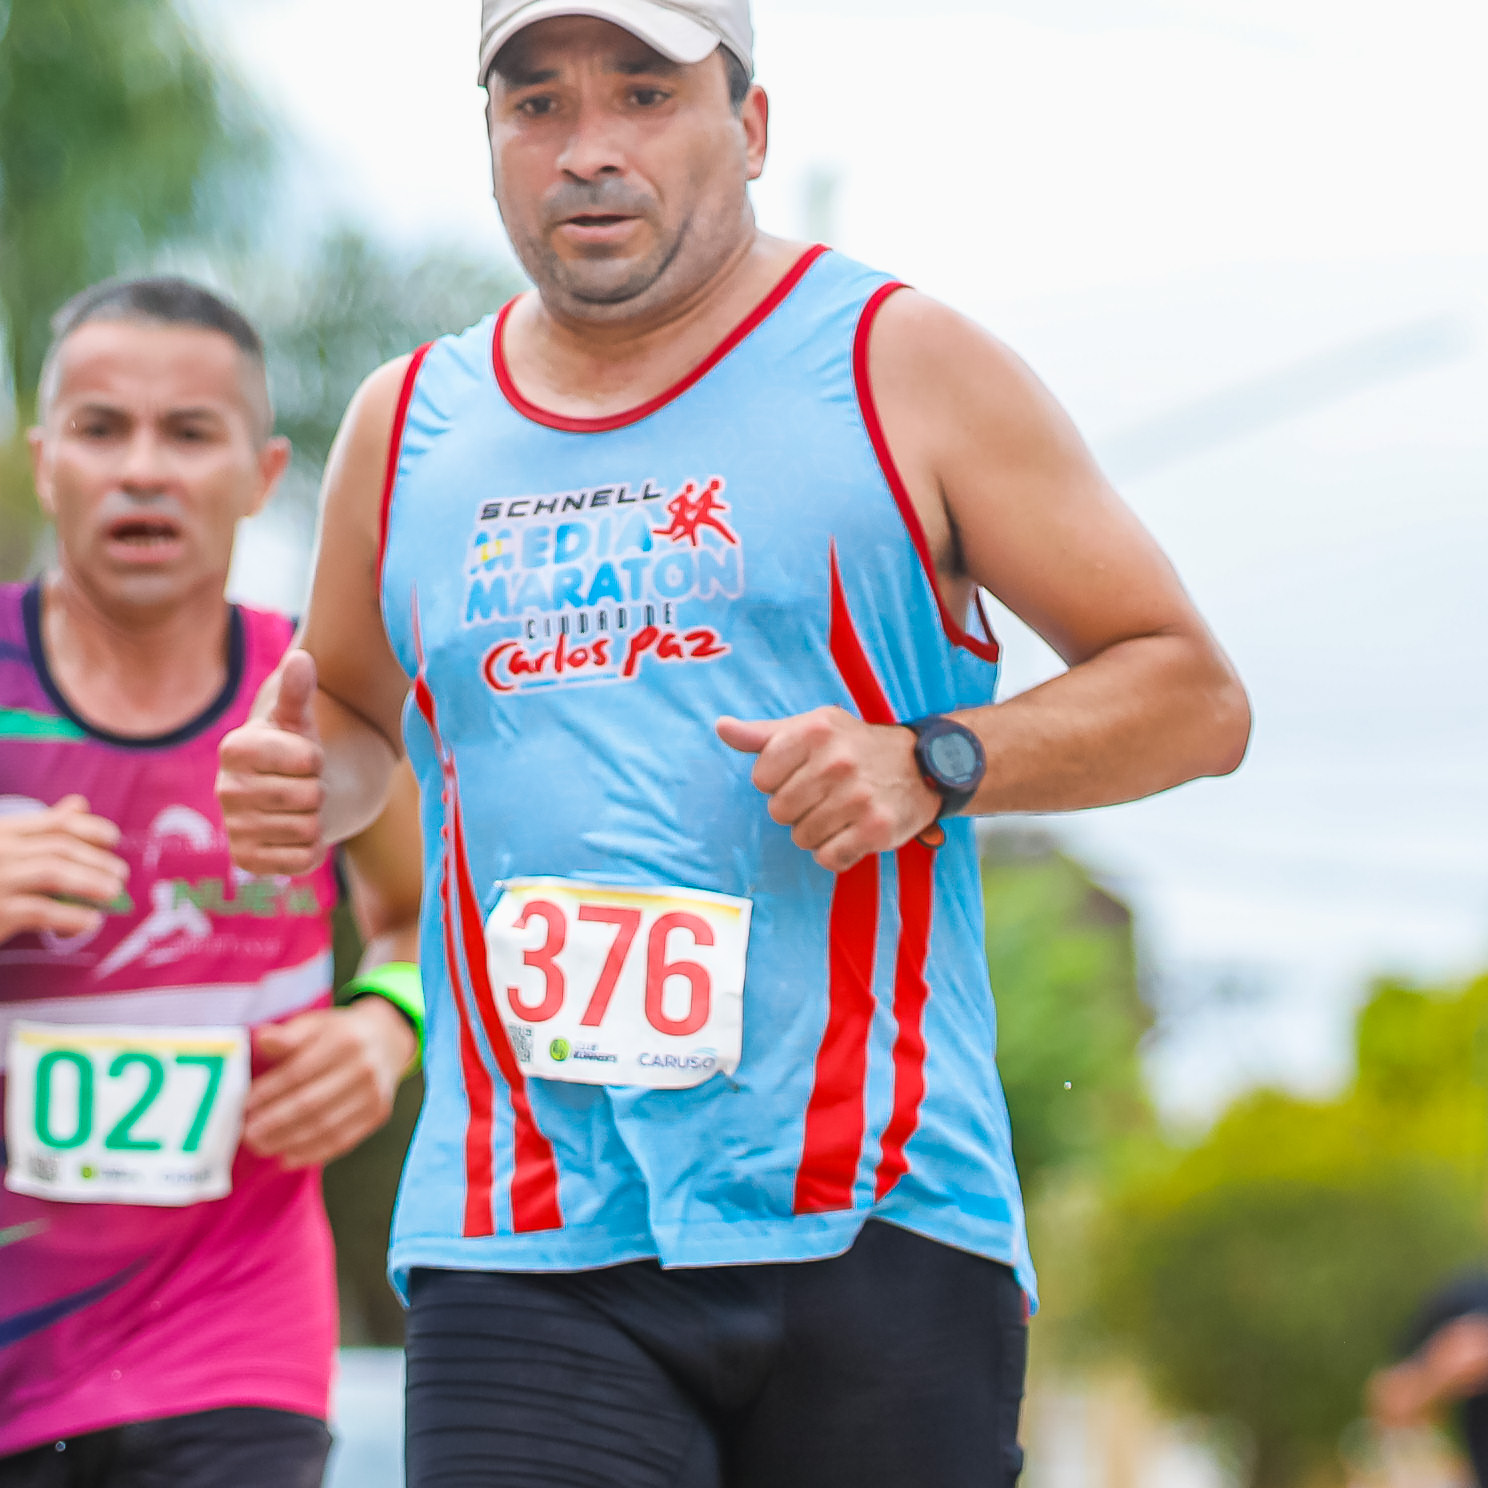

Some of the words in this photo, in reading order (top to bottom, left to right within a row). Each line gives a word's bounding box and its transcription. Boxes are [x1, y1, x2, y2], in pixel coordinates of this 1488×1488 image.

[480, 481, 663, 521] SCHNELL
[468, 507, 654, 576] MEDIA
[464, 548, 742, 624] MARATON
[483, 632, 611, 692] Carlos
[621, 625, 729, 677] Paz
[506, 899, 716, 1037] 376
[638, 1052, 717, 1070] CARUSO
[33, 1049, 226, 1153] 027
